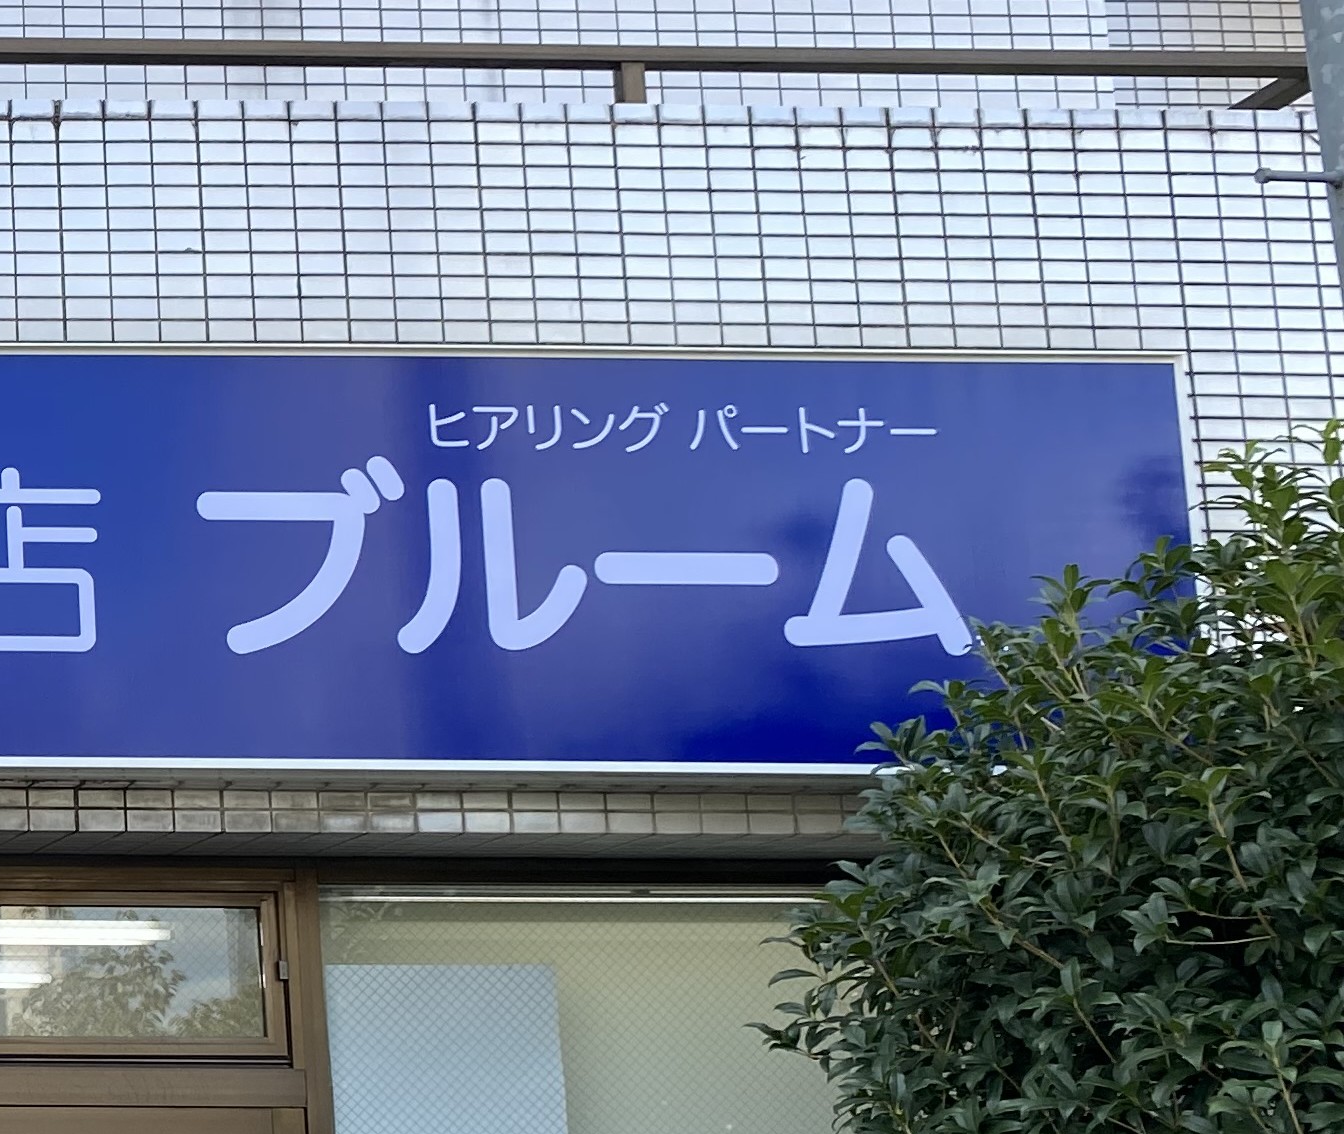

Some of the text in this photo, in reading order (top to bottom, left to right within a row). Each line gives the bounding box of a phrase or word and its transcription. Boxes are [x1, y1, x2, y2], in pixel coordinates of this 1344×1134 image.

[428, 402, 938, 454] ヒアリング パートナー
[196, 456, 973, 656] ブルーム
